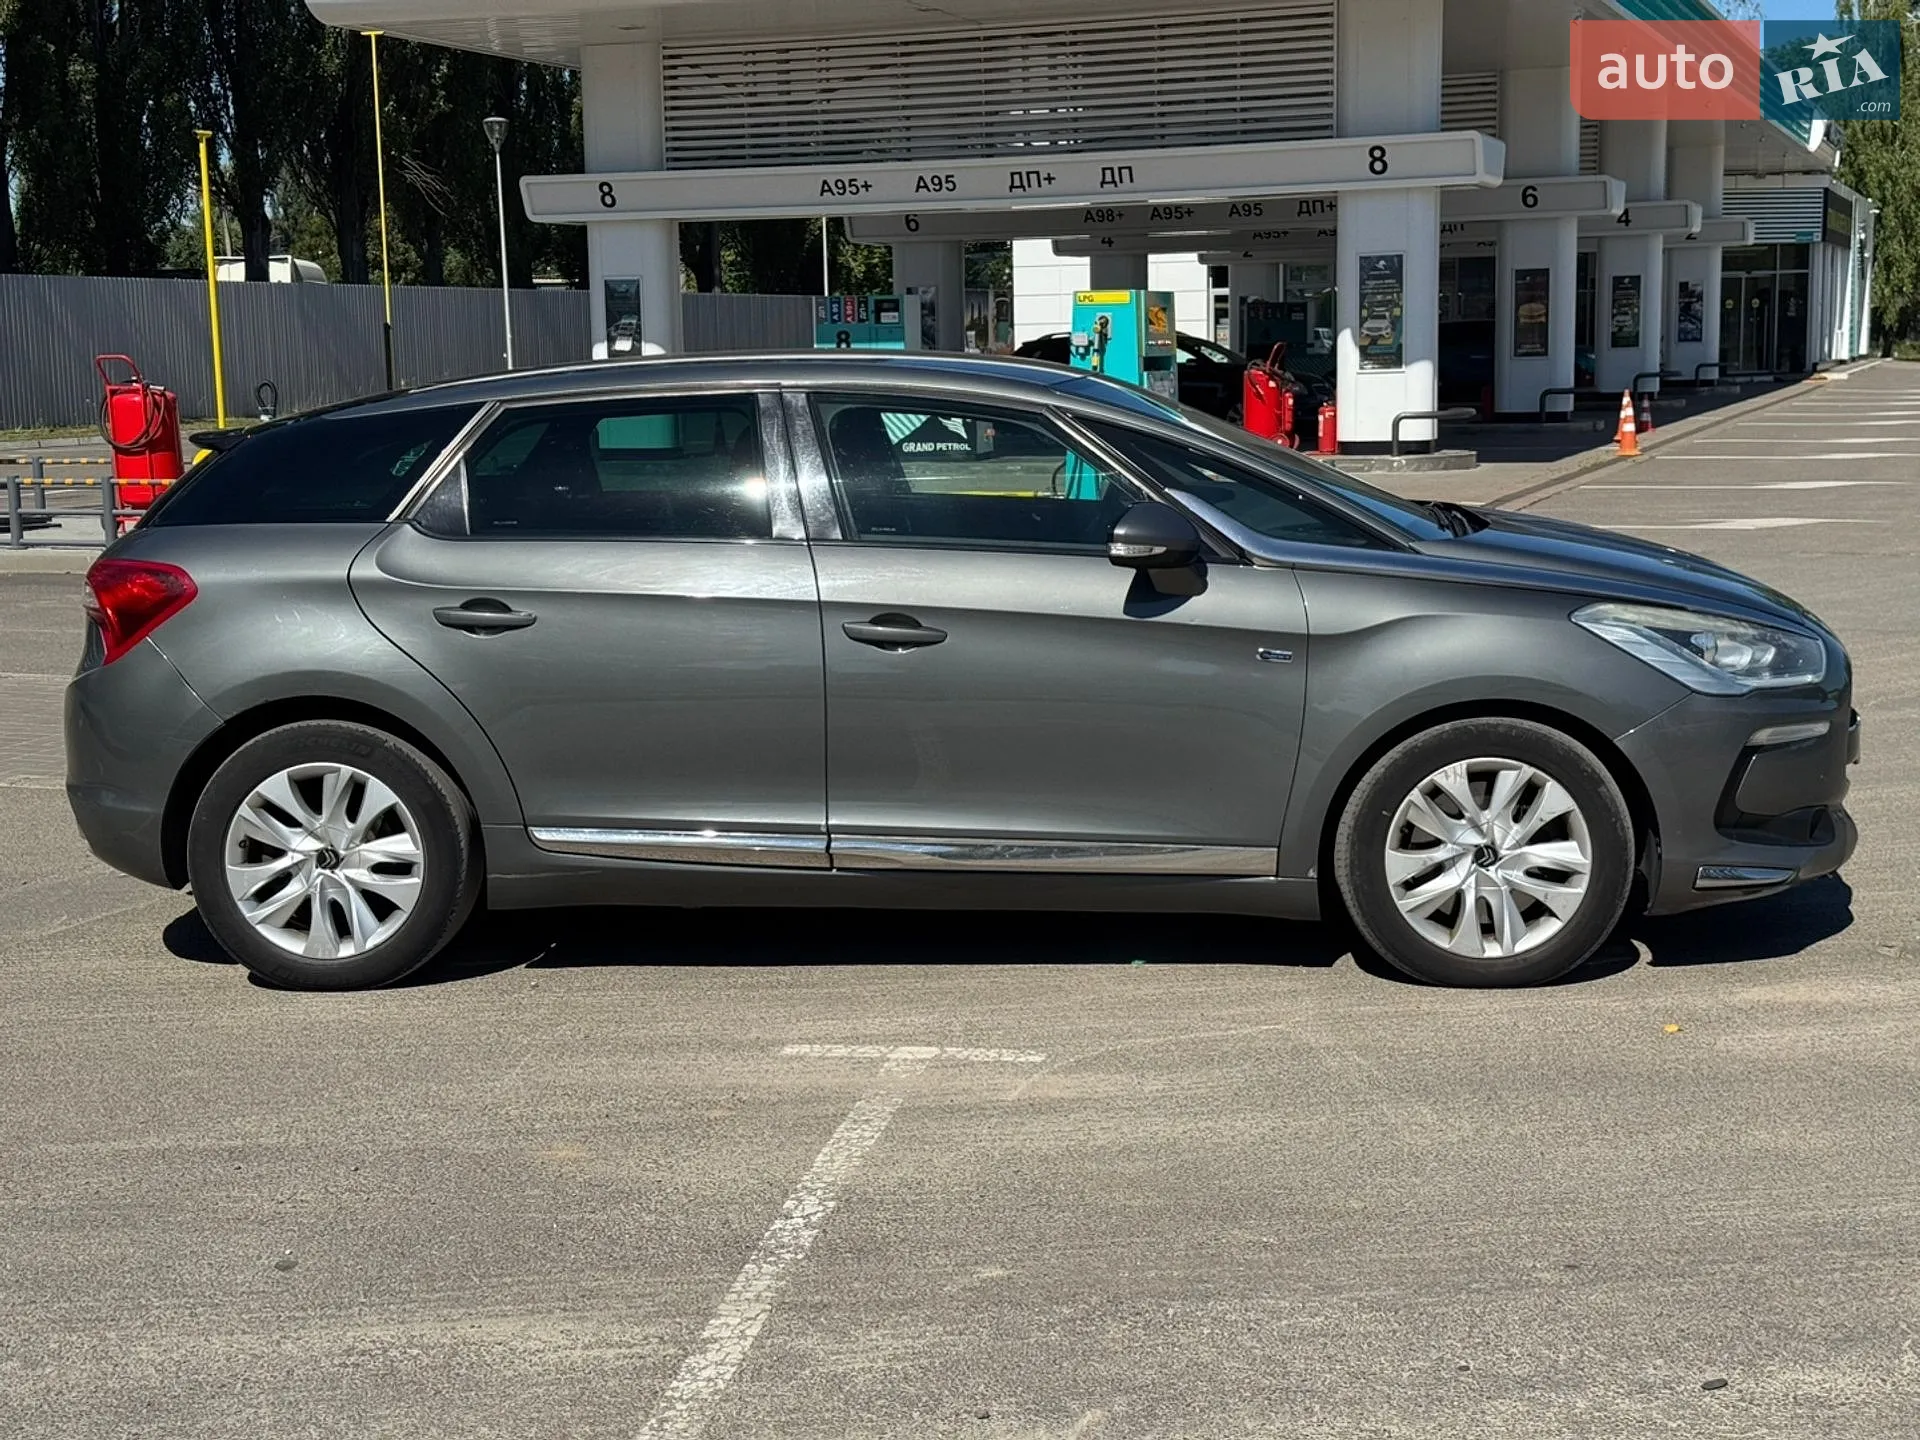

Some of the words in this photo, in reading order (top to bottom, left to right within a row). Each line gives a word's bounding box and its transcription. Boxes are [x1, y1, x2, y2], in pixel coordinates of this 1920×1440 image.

[598, 181, 617, 209] 8
[1008, 170, 1056, 192] ДП+
[1100, 166, 1134, 188] ДП
[1368, 145, 1388, 176] 8
[904, 213, 920, 232] 6
[1297, 199, 1337, 217] ДП+
[1521, 185, 1539, 209] 6
[1616, 207, 1632, 227] 4
[1077, 295, 1094, 303] LPG
[836, 329, 852, 348] 8
[902, 442, 935, 453] GRAND
[936, 442, 972, 452] PETROL
